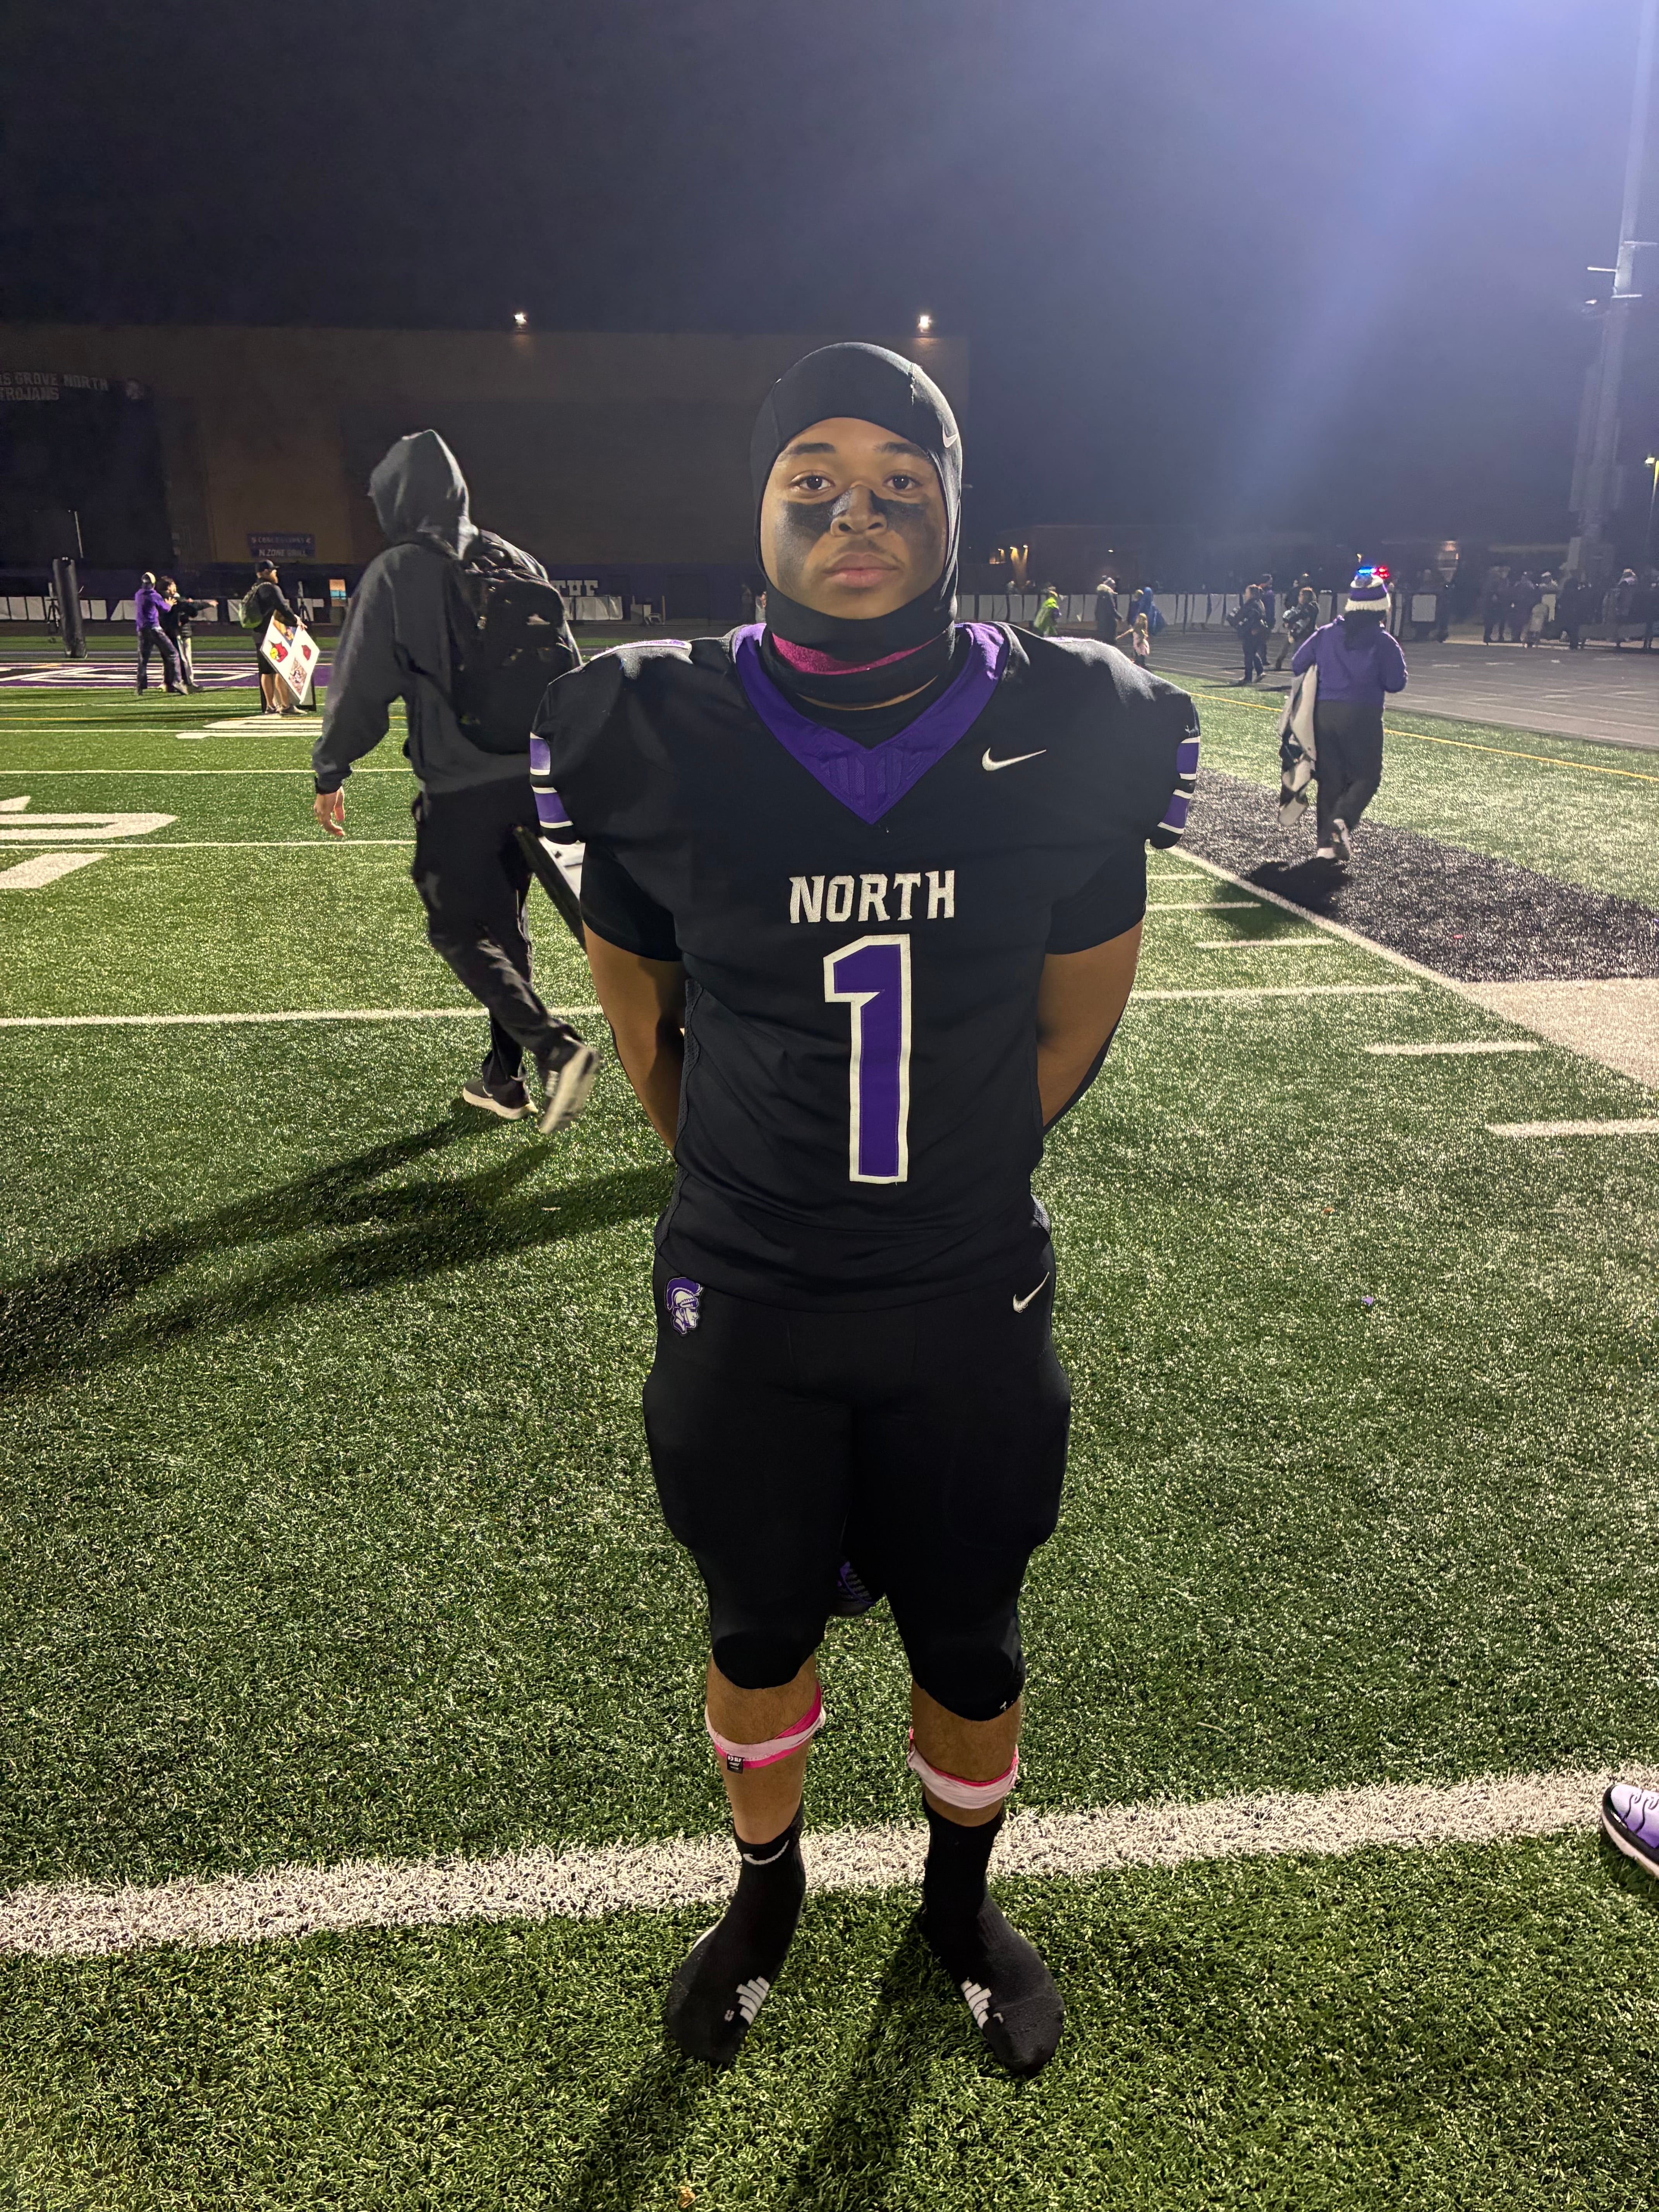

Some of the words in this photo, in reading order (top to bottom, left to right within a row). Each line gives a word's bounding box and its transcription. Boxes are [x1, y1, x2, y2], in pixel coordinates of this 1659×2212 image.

[0, 371, 12, 385] S
[14, 371, 58, 386] GROVE
[63, 374, 109, 391] NORTH
[0, 386, 59, 401] TROJANS
[789, 870, 955, 923] NORTH
[823, 933, 911, 1183] 1
